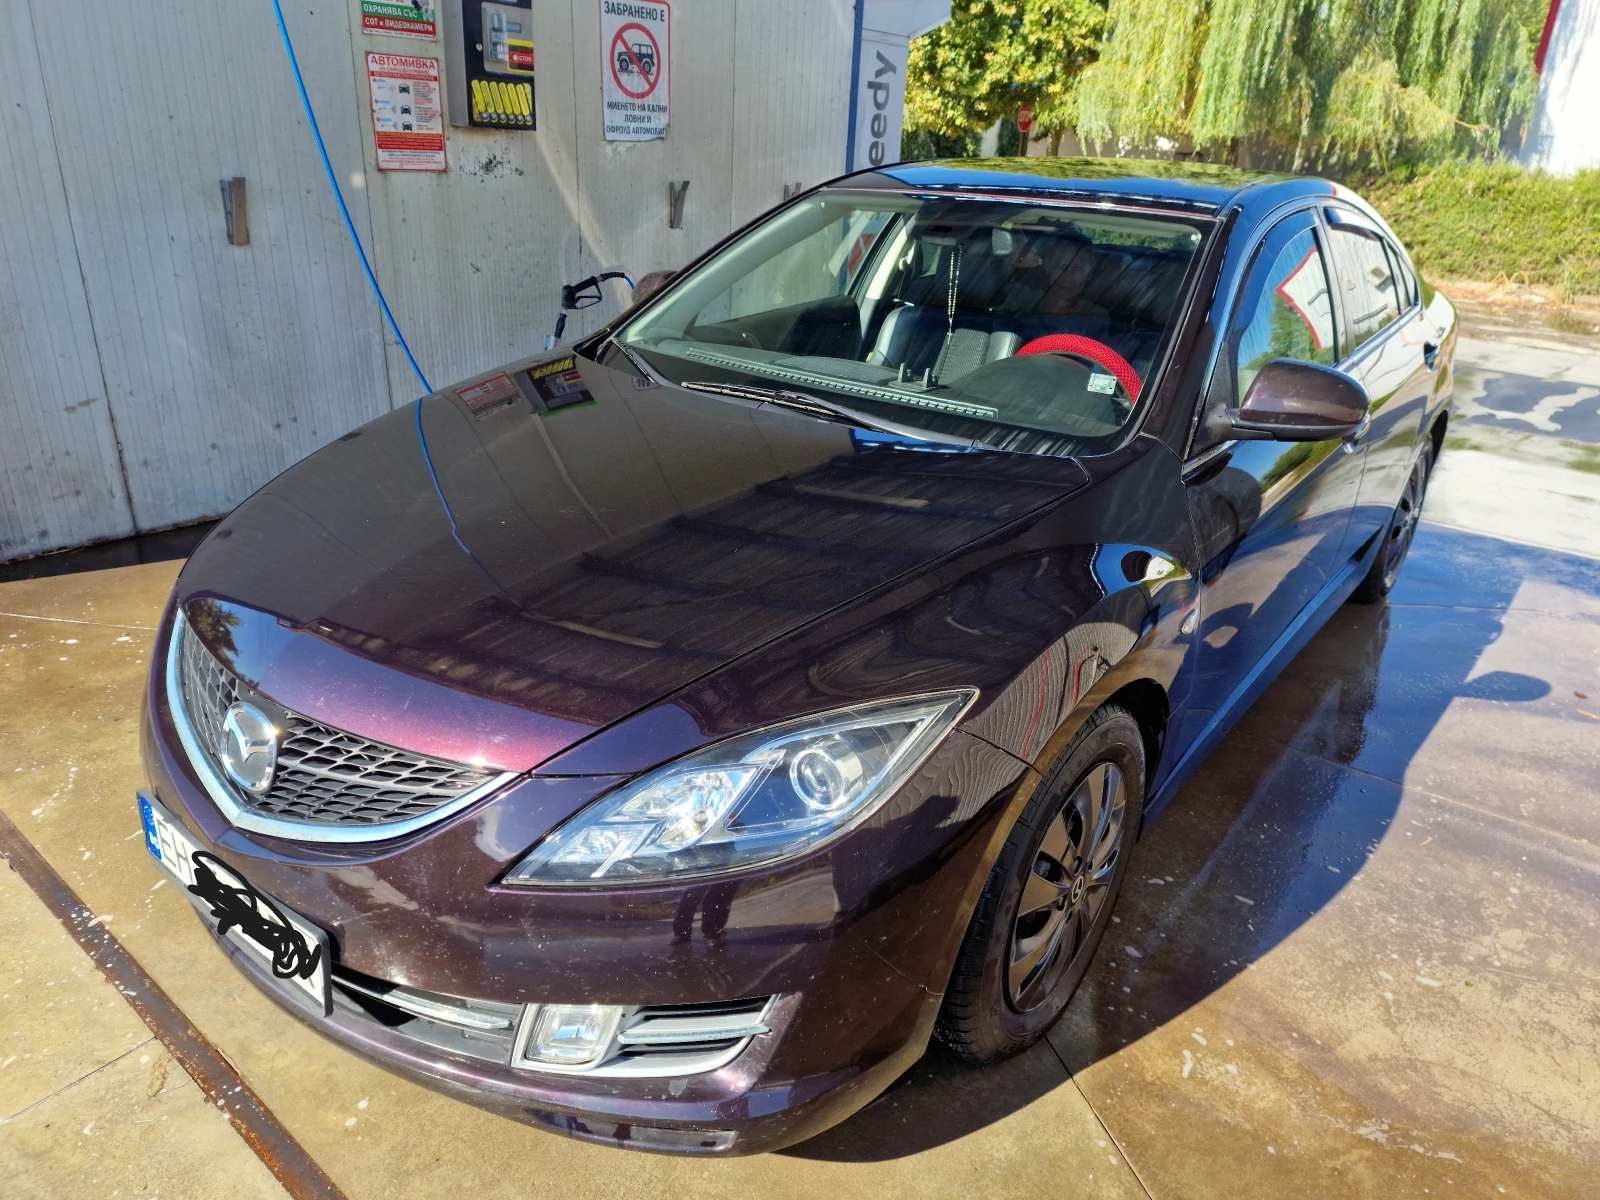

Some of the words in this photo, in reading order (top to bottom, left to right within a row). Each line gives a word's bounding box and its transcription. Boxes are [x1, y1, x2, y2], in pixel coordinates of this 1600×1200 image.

[363, 4, 402, 16] ОХРАНЯВА
[403, 9, 418, 18] СЪС
[604, 1, 658, 21] ЗАБРАНЕНО
[660, 9, 665, 22] Е
[365, 17, 378, 25] СОТ
[384, 20, 433, 32] ВИДЕОКАМЕРИ
[371, 55, 436, 70] АВТОМИВКА
[607, 101, 637, 111] МИЕНЕТО
[637, 103, 646, 112] НА
[647, 103, 668, 113] КАЛНИ
[624, 114, 646, 123] ЛОВНИ
[606, 126, 631, 135] ОФРОУД
